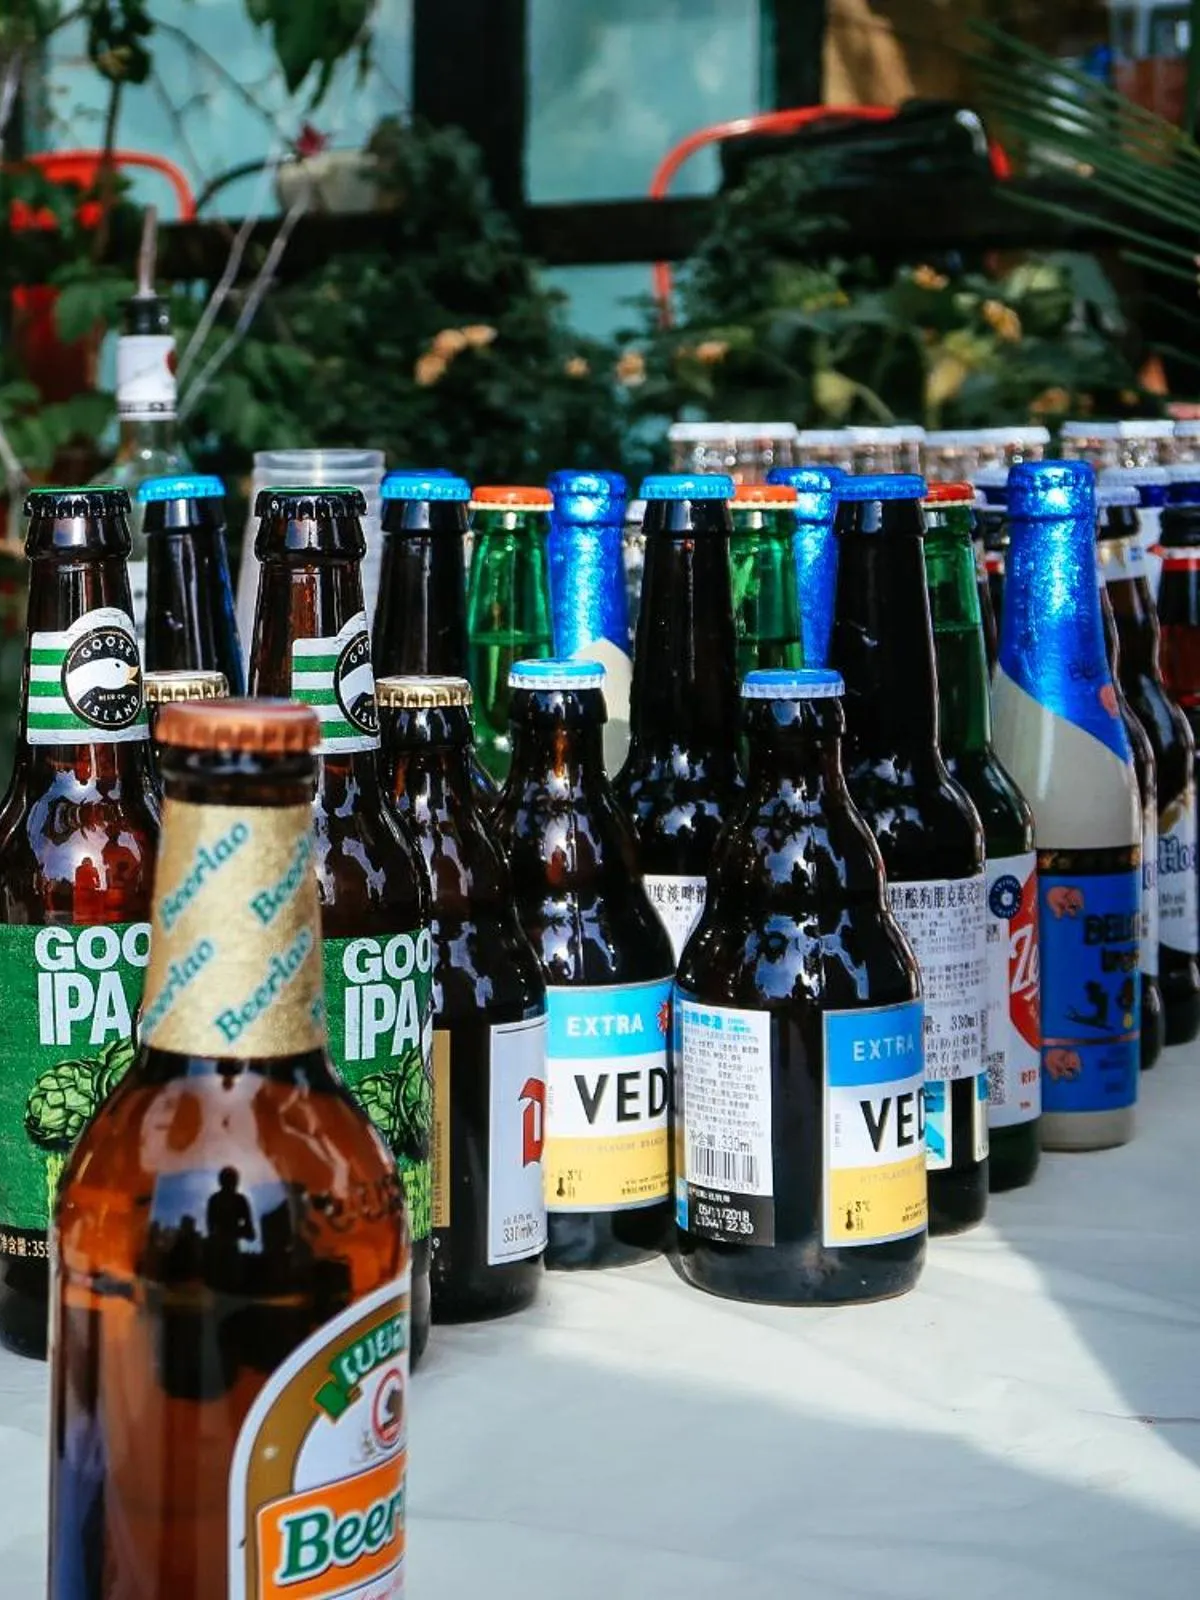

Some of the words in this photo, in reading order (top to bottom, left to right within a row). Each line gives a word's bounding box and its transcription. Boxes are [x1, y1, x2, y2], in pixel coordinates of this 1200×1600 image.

[81, 636, 131, 658] GOOSE
[82, 695, 138, 720] ISLAND
[37, 971, 132, 1045] IPA
[214, 929, 310, 1042] Beerlao
[345, 979, 420, 1060] IPA
[566, 1013, 644, 1037] EXTRA
[853, 1034, 914, 1062] EXTRA
[574, 1066, 670, 1125] VED
[277, 1490, 406, 1582] Beer
